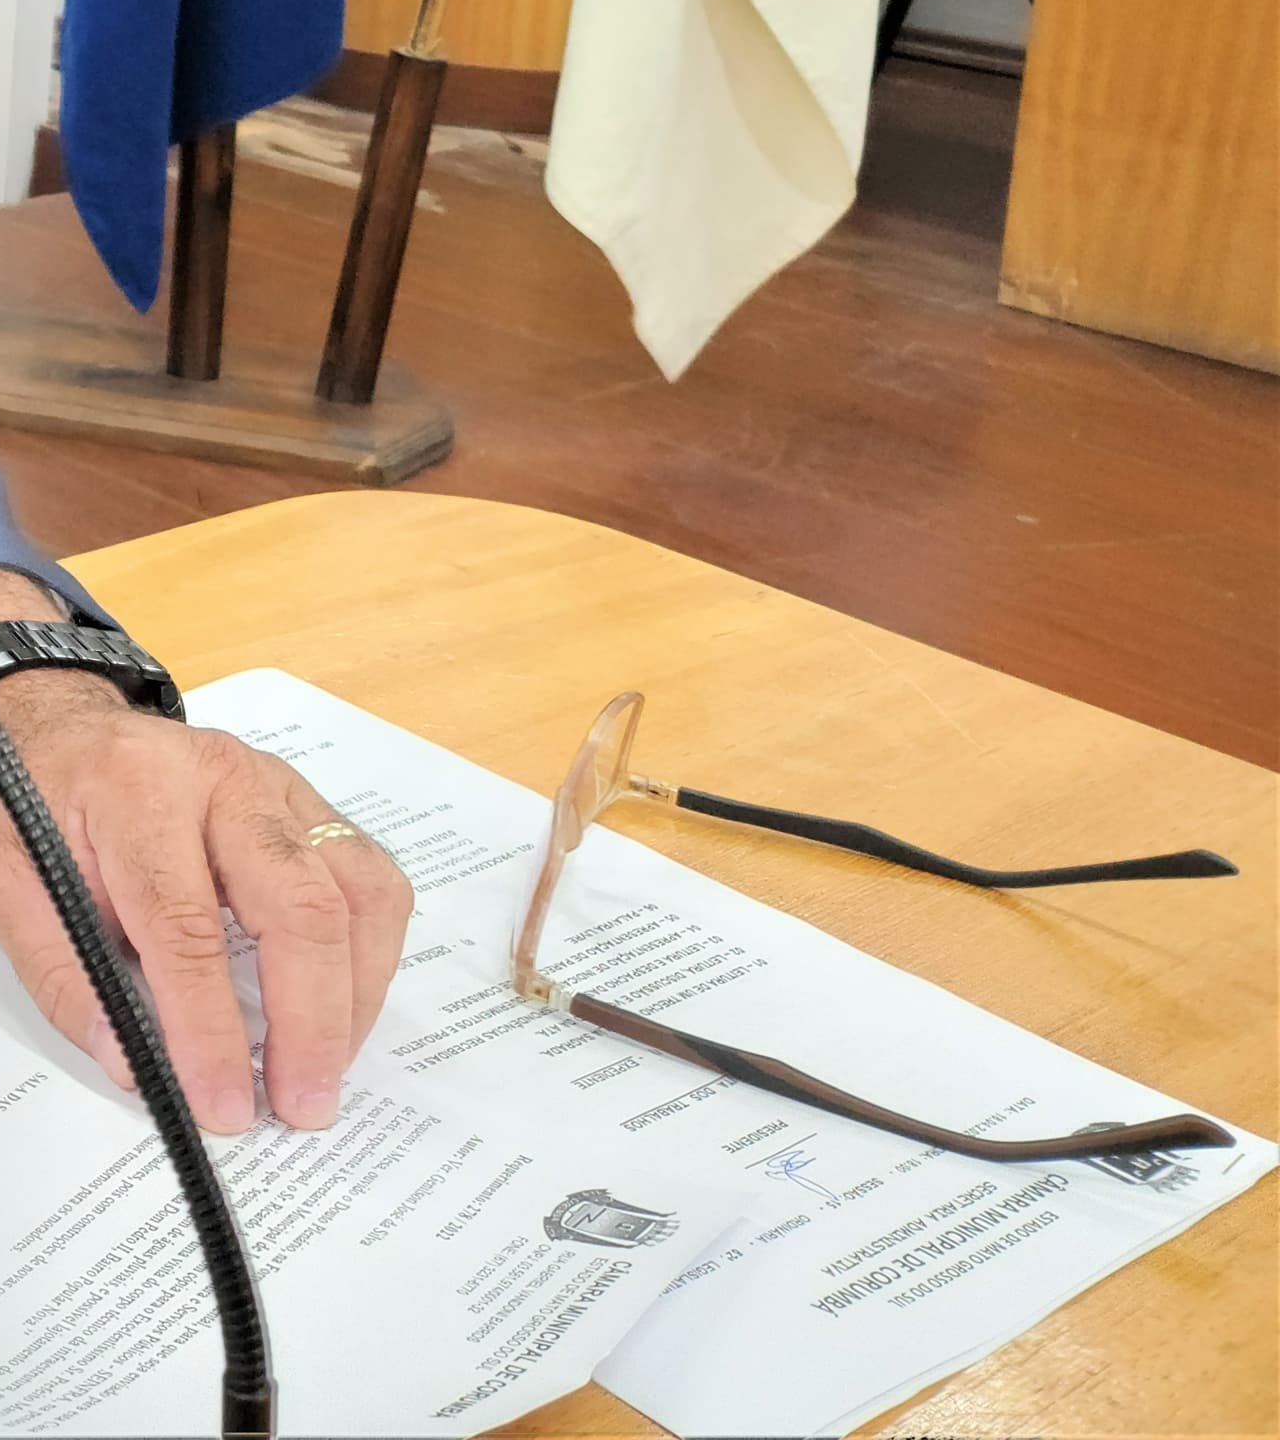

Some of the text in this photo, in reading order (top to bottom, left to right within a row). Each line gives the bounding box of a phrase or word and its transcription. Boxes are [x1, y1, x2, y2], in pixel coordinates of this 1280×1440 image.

[590, 910, 640, 934] PALAVRA
[584, 920, 660, 956] APRESENTAÇÃO
[606, 932, 682, 966] APRESENTAÇÃO
[604, 942, 706, 988] LEITURA DESPACHO
[706, 966, 750, 986] LEITURA
[628, 972, 688, 998] DISCUSSÃO
[692, 982, 712, 994] DE
[640, 996, 682, 1016] TRECHO
[424, 1036, 486, 1066] RECEBIDAS
[14, 1072, 48, 1094] SALA
[574, 1058, 640, 1090] EXPEDIENTE
[366, 1106, 388, 1122] seu
[378, 1096, 396, 1108] de
[400, 1106, 418, 1116] de
[620, 1086, 716, 1132] DOS TRABALHOS
[1004, 1096, 1036, 1114] DATA:
[332, 1116, 376, 1152] Secretário
[452, 1134, 484, 1160] Autor:
[720, 1120, 788, 1154] PRESIDENTE
[258, 1148, 276, 1158] de
[344, 1132, 388, 1168] expediente
[88, 1152, 138, 1190] transtornos
[228, 1156, 264, 1186] serviços
[288, 1150, 342, 1186] Municipal,
[68, 1186, 92, 1206] para
[112, 1180, 134, 1198] pois
[302, 1172, 348, 1208] Secretaria
[404, 1174, 446, 1206] Genilson
[436, 1154, 534, 1240] Requerimento: 278 2022
[58, 1204, 72, 1216] os
[92, 1196, 116, 1214] com
[148, 1202, 180, 1224] Dom
[244, 1200, 284, 1230] Ricardo
[390, 1202, 416, 1220] José
[10, 1214, 62, 1252] moradores.
[42, 1214, 96, 1256] construções
[126, 1222, 160, 1244] Pedro
[166, 1226, 184, 1238] de
[262, 1206, 312, 1244] Municipal
[360, 1226, 388, 1246] Silva
[378, 1218, 398, 1228] da
[754, 1214, 812, 1244] ORDINÁRIA
[820, 1182, 998, 1278] SECRETARIA ADMINISTRATIVA
[30, 1254, 48, 1266] de
[98, 1114, 442, 1398] Requeiro Mesa, ouvido Douto Plenário, na para que seja enviado
[142, 1236, 174, 1260] águas
[810, 1174, 1070, 1318] CÂMARA MUNICIPAL DE CORUMBÁ
[888, 1210, 1060, 1308] ESTADO DE MATO GROSSO DO SUL
[0, 1136, 320, 1392] solicitando que visita do corpo técnico da infraestrutura,
[2, 1264, 34, 1288] novas
[86, 1252, 122, 1278] Bairro
[104, 1254, 148, 1288] pluviais,
[524, 1264, 562, 1292] GABRIEL
[50, 1276, 94, 1306] Popular
[170, 1272, 198, 1292] cópia
[60, 1290, 104, 1328] possível
[150, 1290, 176, 1308] para
[474, 1256, 610, 1372] ESTADO DE MATO GROSSO DO SUL
[152, 1304, 198, 1336] Serviços
[8, 1324, 72, 1366] lajotamento
[112, 1334, 162, 1366] Públicos
[430, 1260, 632, 1418] CÂMARA MUNICIPAL DE CORUMBÁ
[22, 1376, 70, 1402] Prefeito
